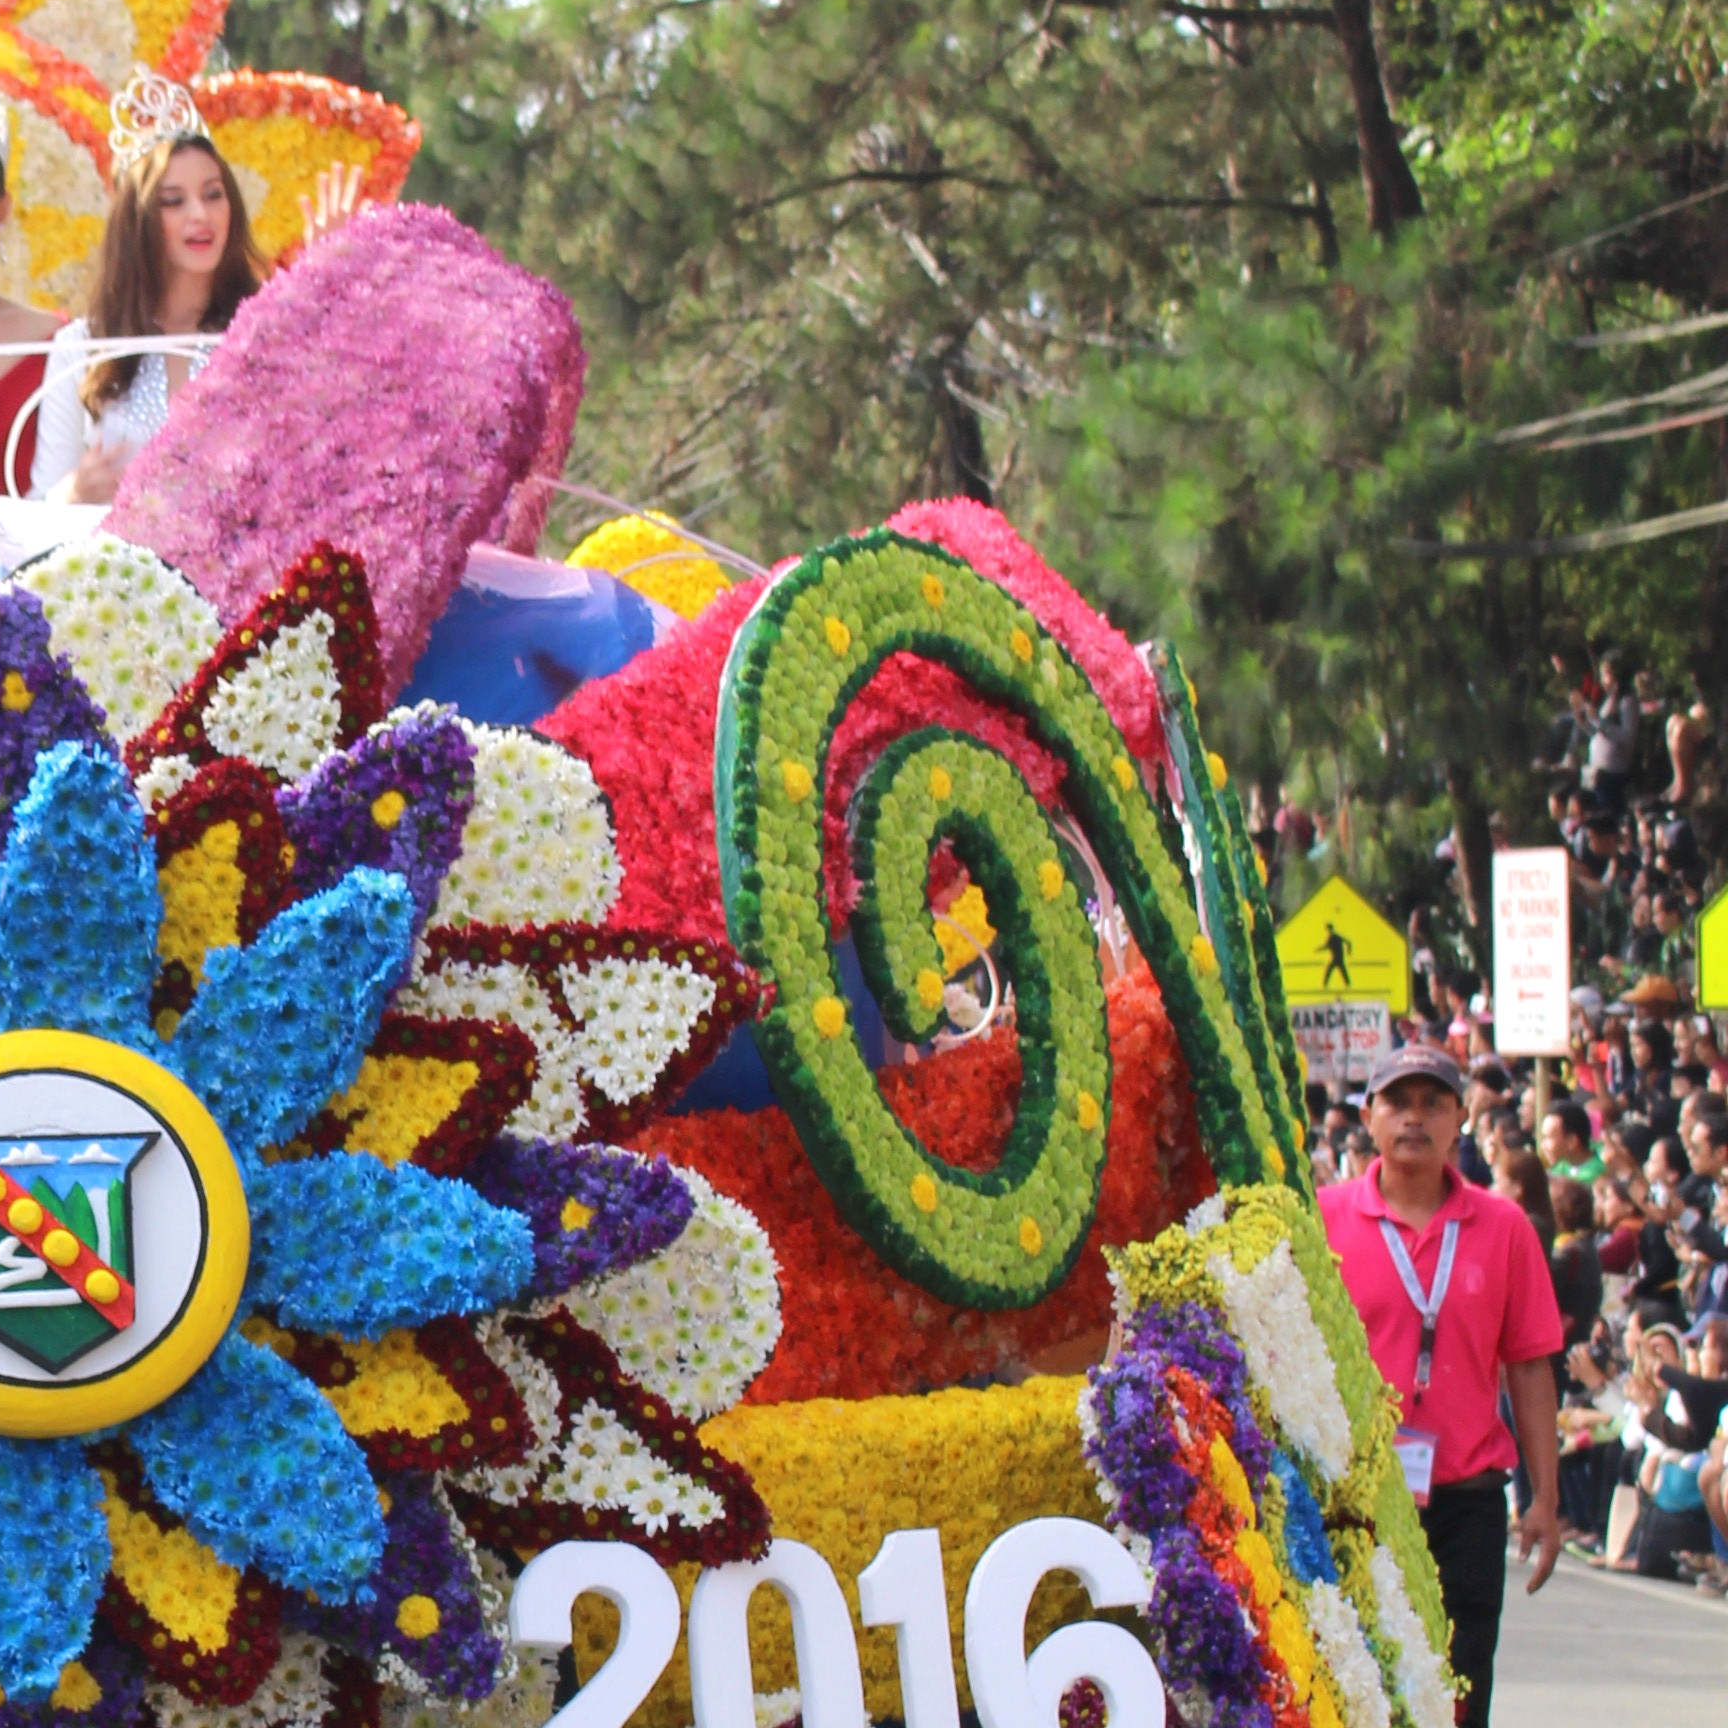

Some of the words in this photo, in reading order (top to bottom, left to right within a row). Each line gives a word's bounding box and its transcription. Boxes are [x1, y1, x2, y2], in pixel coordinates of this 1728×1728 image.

[1507, 869, 1551, 892] STRICTLY
[1499, 898, 1513, 919] NO
[1518, 897, 1560, 919] PARKING
